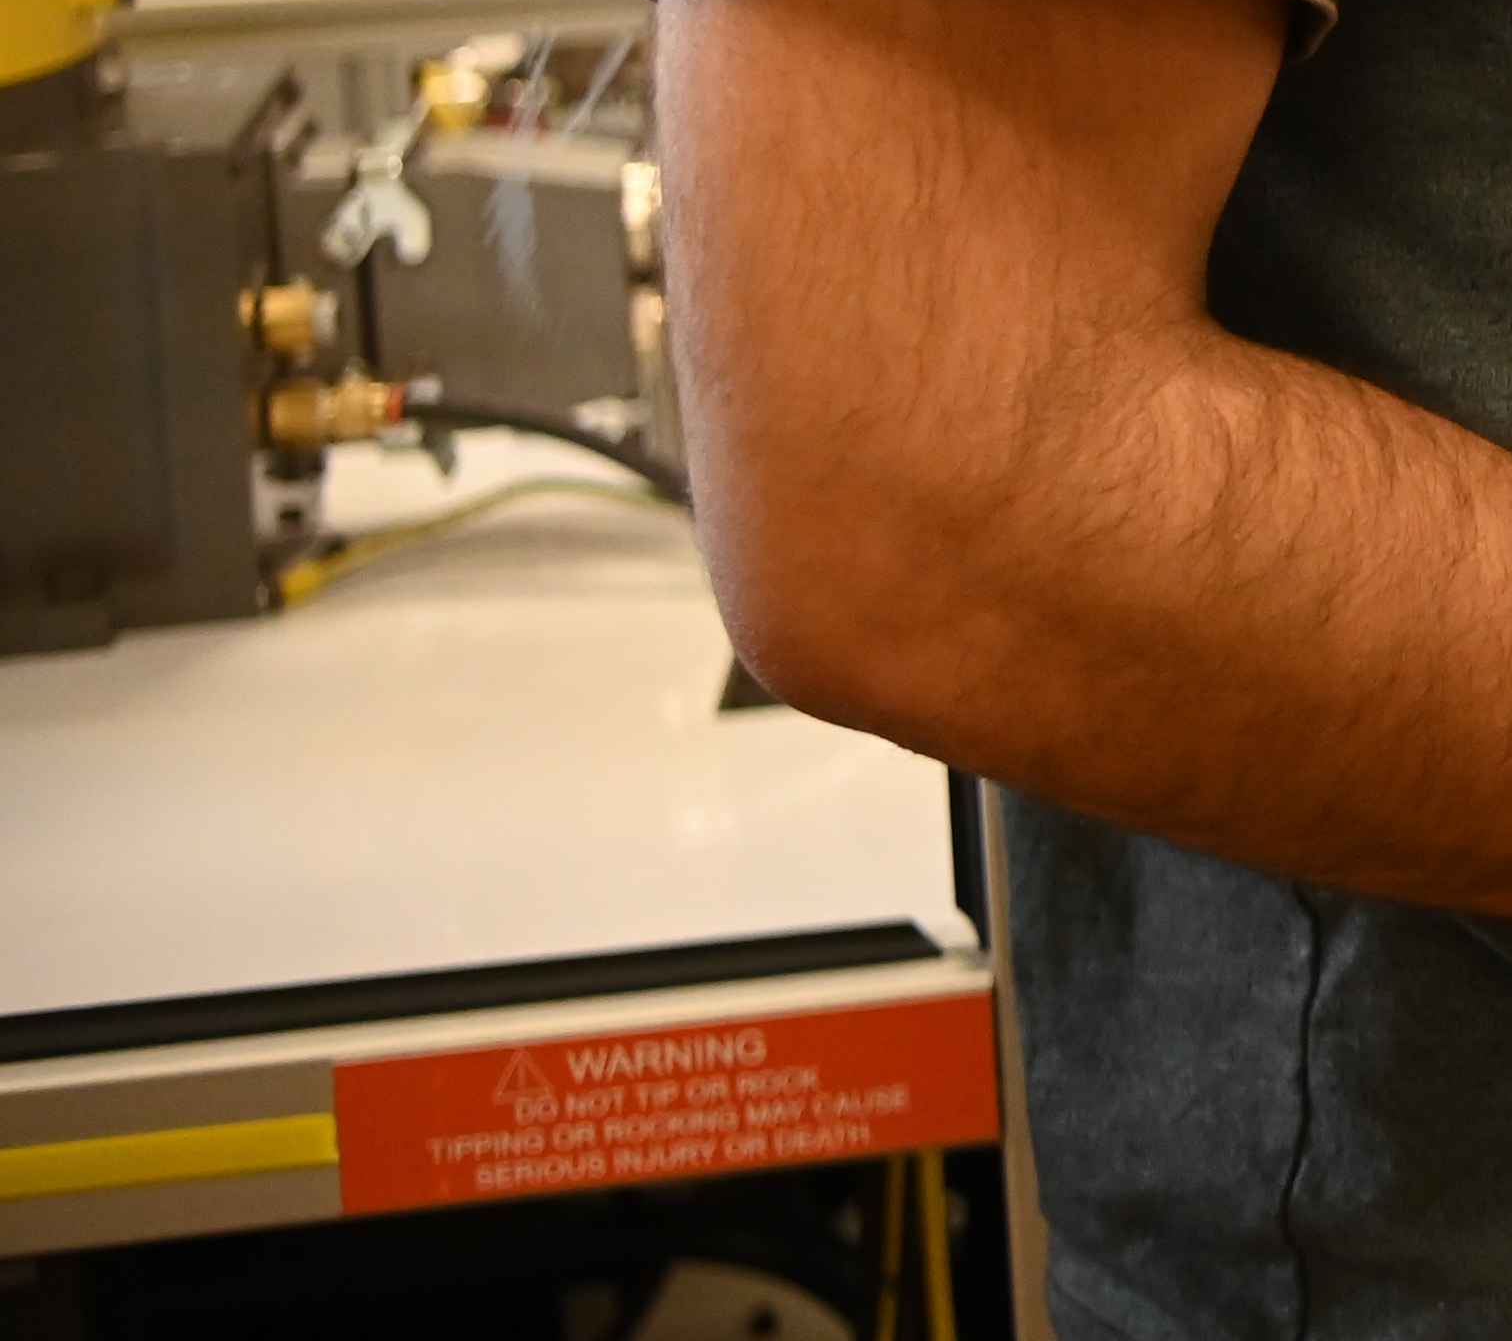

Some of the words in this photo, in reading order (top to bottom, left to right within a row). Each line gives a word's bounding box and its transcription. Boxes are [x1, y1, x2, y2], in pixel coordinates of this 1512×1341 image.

[566, 1028, 767, 1084] WARNING
[429, 1125, 546, 1165] TIPPING
[551, 1119, 597, 1152] OR
[603, 1103, 740, 1145] ROCKING
[745, 1095, 807, 1129] MAY
[811, 1083, 912, 1120] CAUSE
[514, 1094, 560, 1126] DO
[564, 1083, 627, 1120] NOT
[632, 1078, 681, 1111] TIP
[684, 1072, 731, 1106] OR
[735, 1064, 820, 1100] ROCK
[475, 1149, 608, 1191] SERIOUS
[612, 1138, 718, 1177] INJURY
[722, 1129, 769, 1162] OR
[774, 1120, 871, 1158] DEATH
